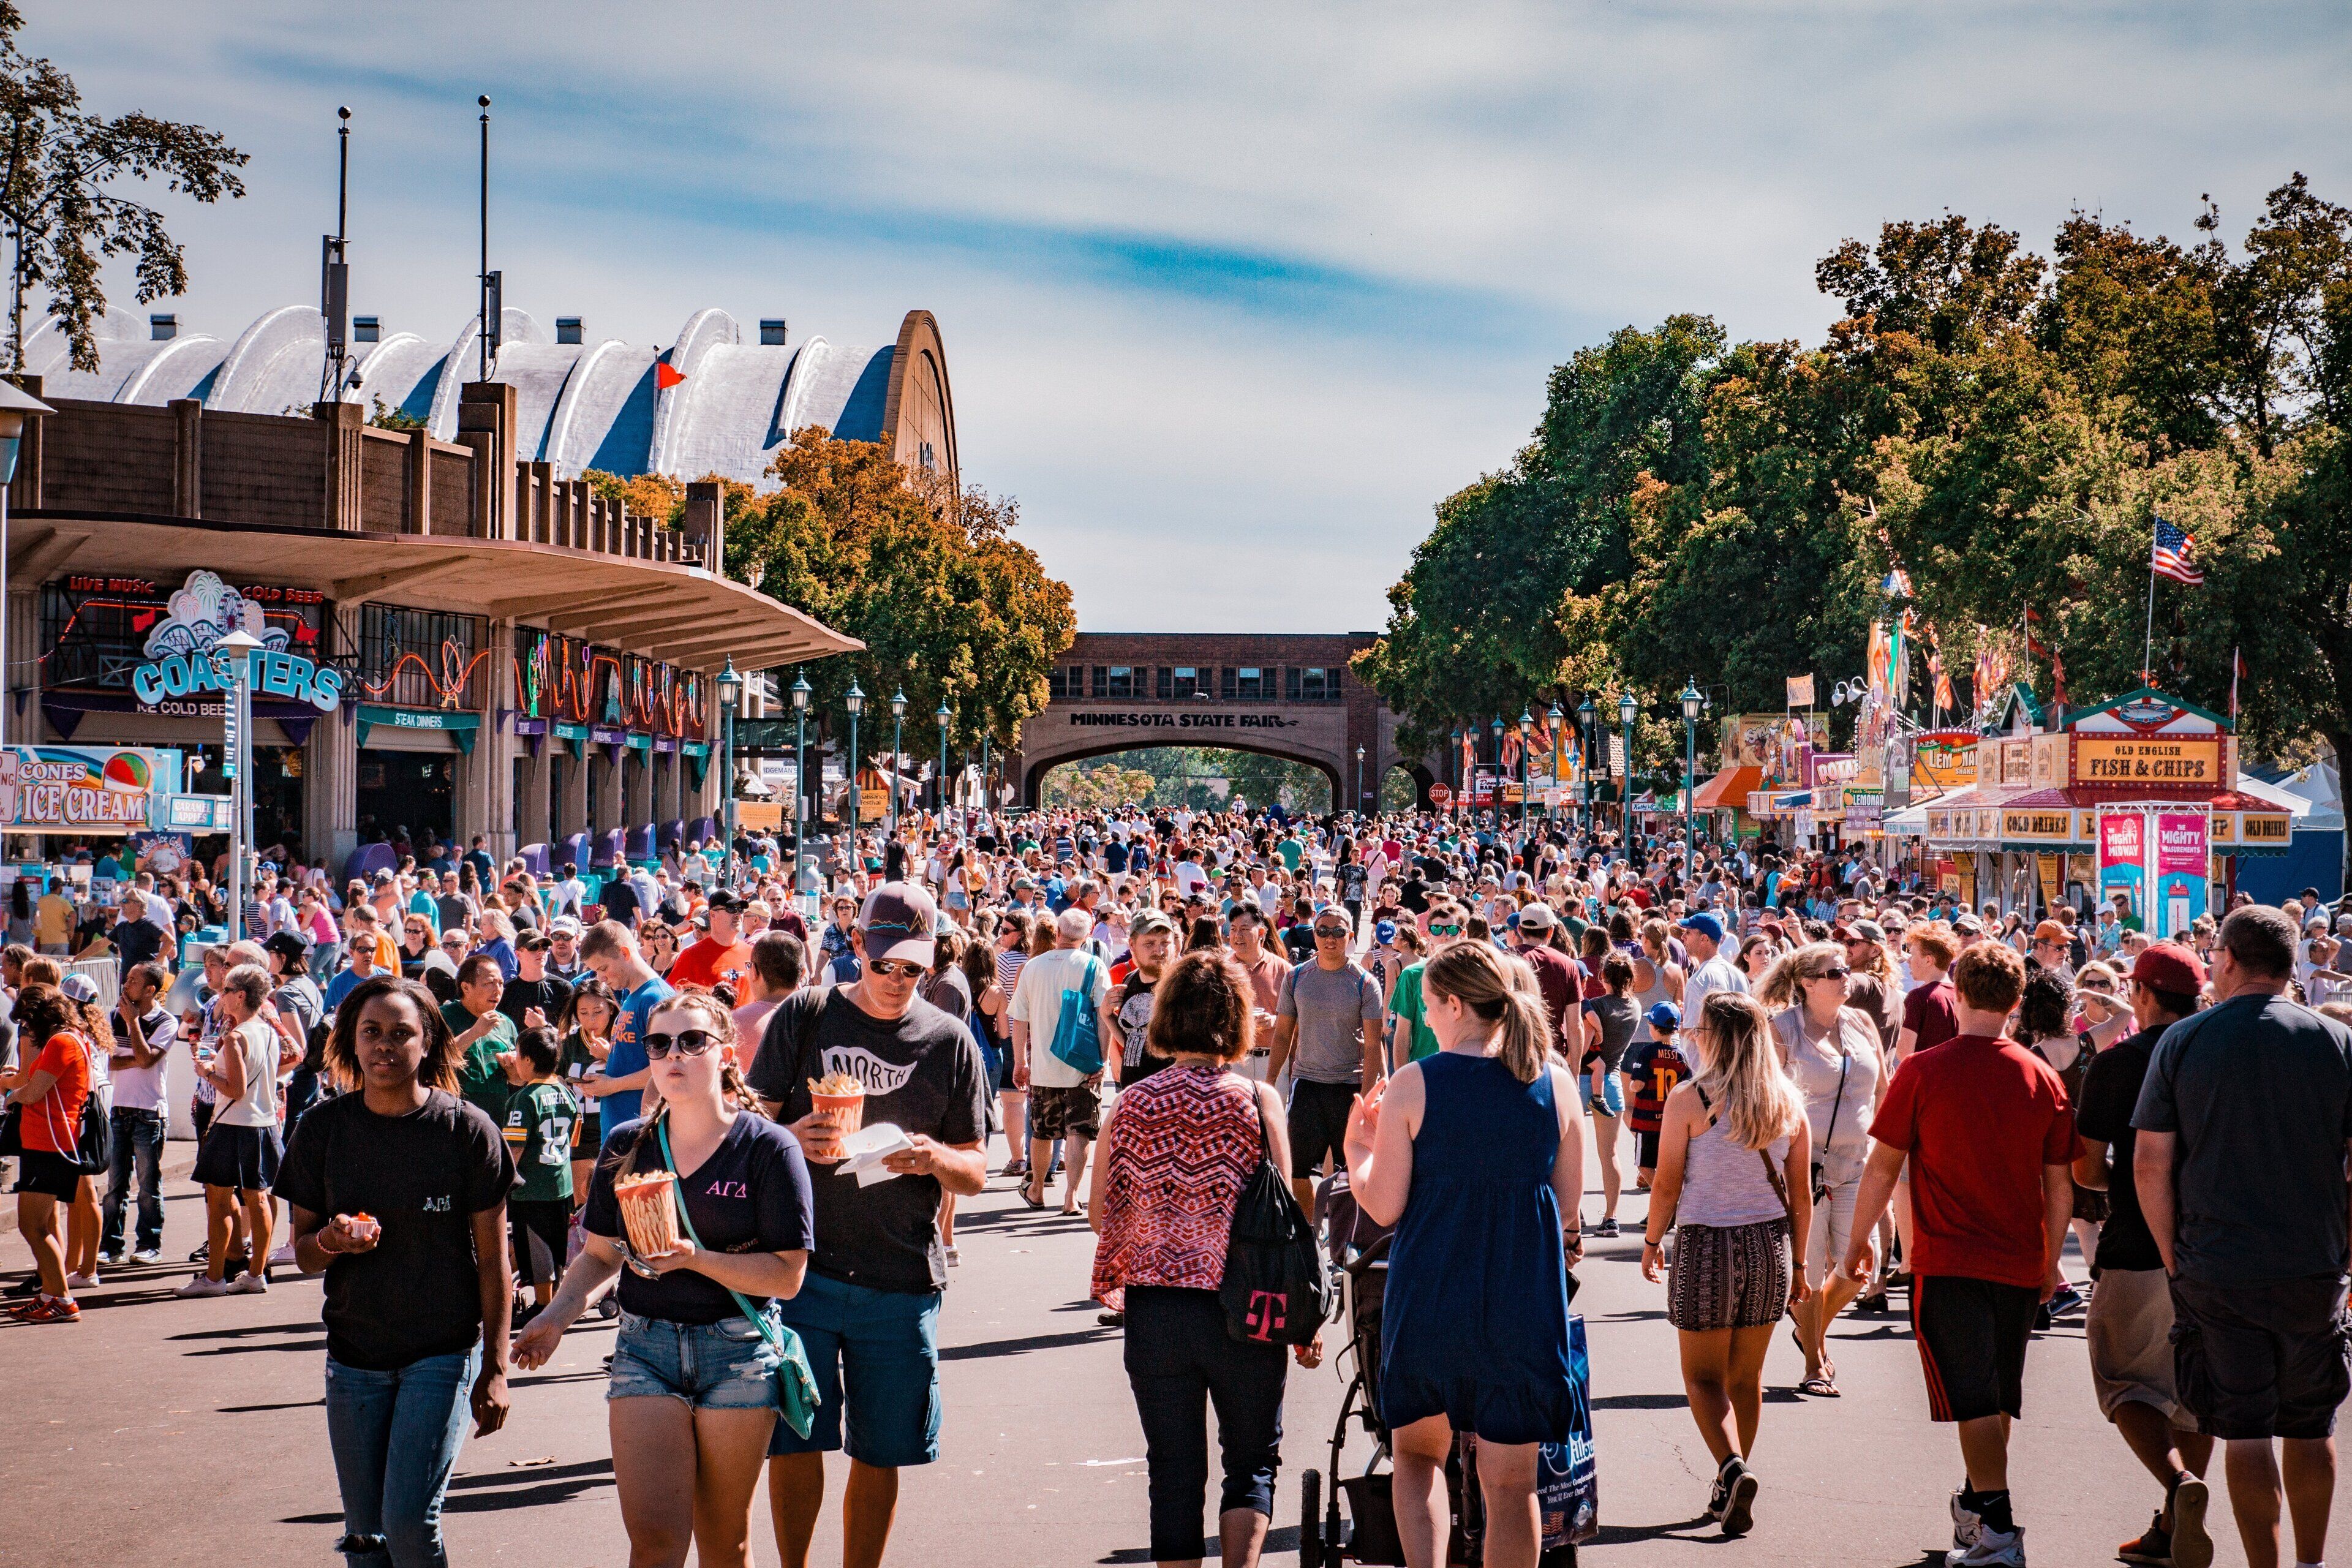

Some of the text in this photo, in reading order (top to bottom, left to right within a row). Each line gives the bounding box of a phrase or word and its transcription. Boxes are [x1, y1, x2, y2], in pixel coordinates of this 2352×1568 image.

[70, 576, 155, 595] LIVE MUSIC
[241, 586, 323, 604] COLD BEER
[133, 648, 342, 712] COASTERS
[160, 703, 198, 716] COLD
[201, 704, 225, 717] BEE
[395, 712, 416, 726] STEAK
[1070, 713, 1299, 728] MINNESOTA STATE FAIR
[2115, 746, 2181, 756] OLD ENGLISH
[19, 763, 87, 781] CONES
[2090, 759, 2205, 778] FISH & CHIPS
[22, 784, 145, 822] ICE CREAM
[1853, 794, 1884, 806] LEMONAD
[175, 802, 211, 814] CARAMEL
[177, 812, 208, 824] APPLES
[2007, 816, 2067, 833] COLD DRINKS
[1885, 824, 1898, 833] YES!
[1900, 824, 1908, 833] We
[1909, 824, 1923, 834] have
[2245, 820, 2261, 836] COLD
[2263, 820, 2286, 836] DRINKS
[2107, 833, 2137, 845] MIGHTY
[2162, 831, 2200, 845] MIGHTY
[137, 839, 157, 858] Bacon
[156, 834, 168, 844] Ice
[2108, 845, 2138, 857] MIDWAY
[1657, 1049, 1678, 1060] MESSI
[832, 1054, 906, 1090] NORTH
[1653, 1068, 1678, 1101] 10
[508, 1110, 522, 1126] 12
[1549, 1483, 1559, 1493] The
[1560, 1480, 1572, 1490] Most
[1547, 1493, 1562, 1504] You'll
[1563, 1490, 1574, 1500] Ever
